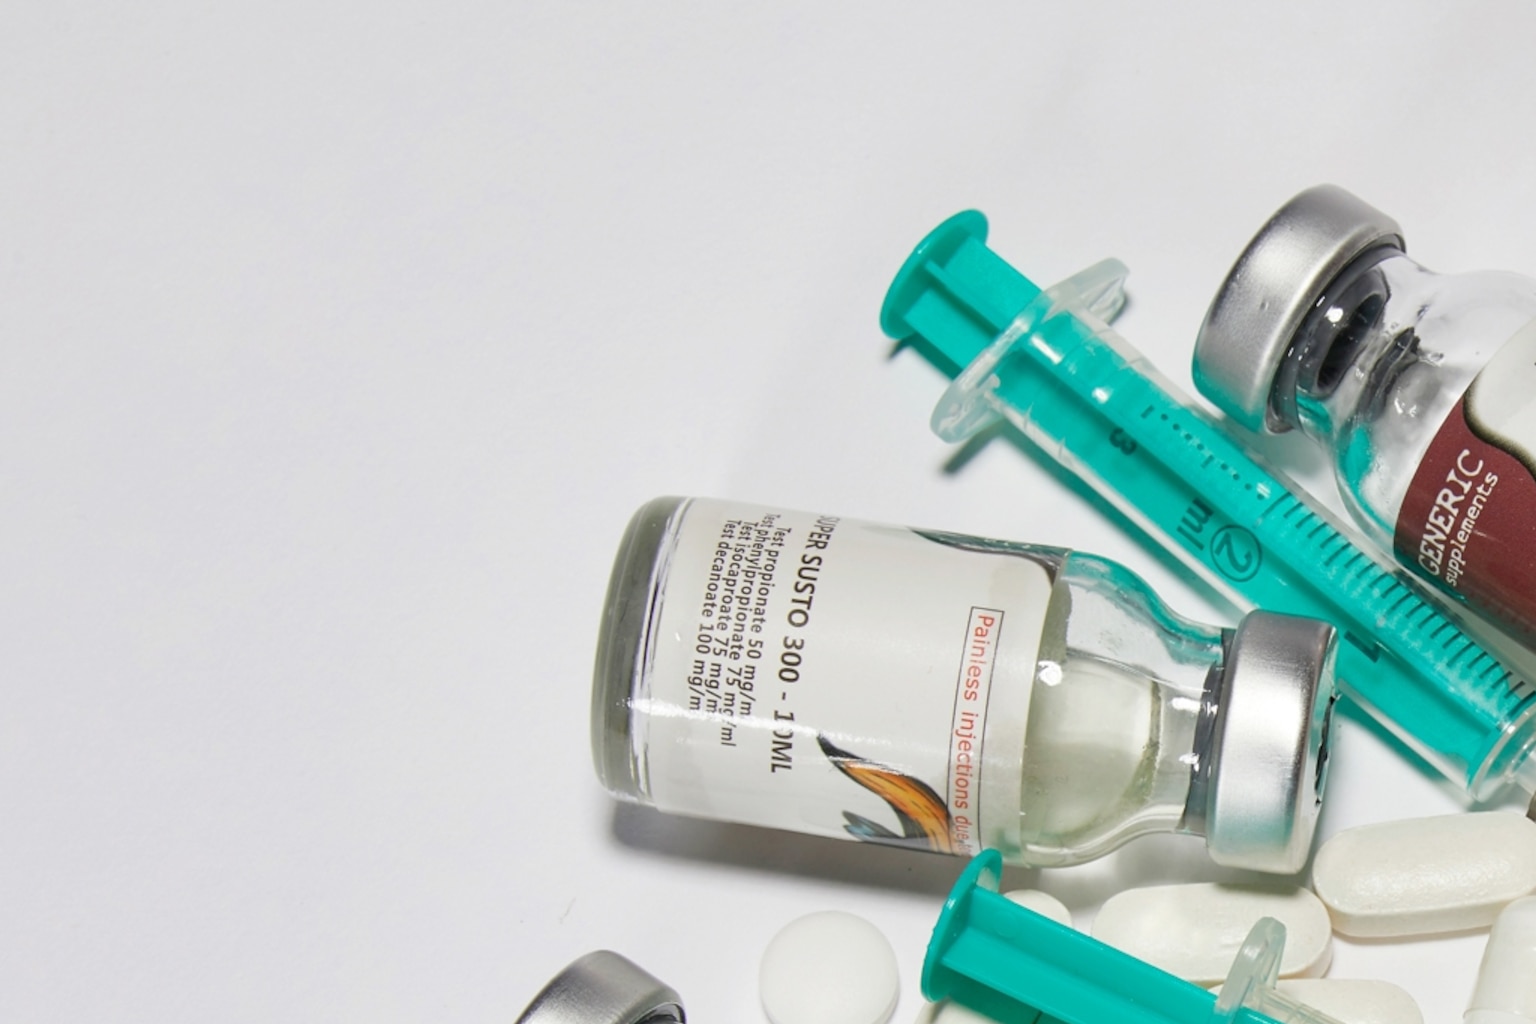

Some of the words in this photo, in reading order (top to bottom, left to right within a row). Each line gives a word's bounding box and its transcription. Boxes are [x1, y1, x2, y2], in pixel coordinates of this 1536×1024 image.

[1109, 428, 1137, 456] 3
[720, 519, 742, 539] Test
[737, 521, 759, 541] Test
[771, 527, 792, 547] Test
[1176, 497, 1214, 550] ml
[1418, 449, 1484, 576] GENERIC
[1445, 472, 1499, 587] supplements
[1213, 530, 1255, 575] 2
[702, 541, 733, 618] decanoate
[716, 542, 751, 631] isocaproate
[729, 527, 771, 661] phenylpropionate
[750, 548, 780, 633] propionate
[787, 554, 822, 628] SUSTO
[695, 623, 714, 655] 100
[712, 637, 730, 657] 75
[746, 639, 764, 660] 50
[778, 636, 805, 683] 300
[963, 614, 995, 701] Painless
[687, 659, 705, 711] mg/m
[704, 662, 723, 714] mg/m
[726, 667, 742, 687] 75
[739, 664, 757, 718] mg/m
[954, 710, 979, 810] injections
